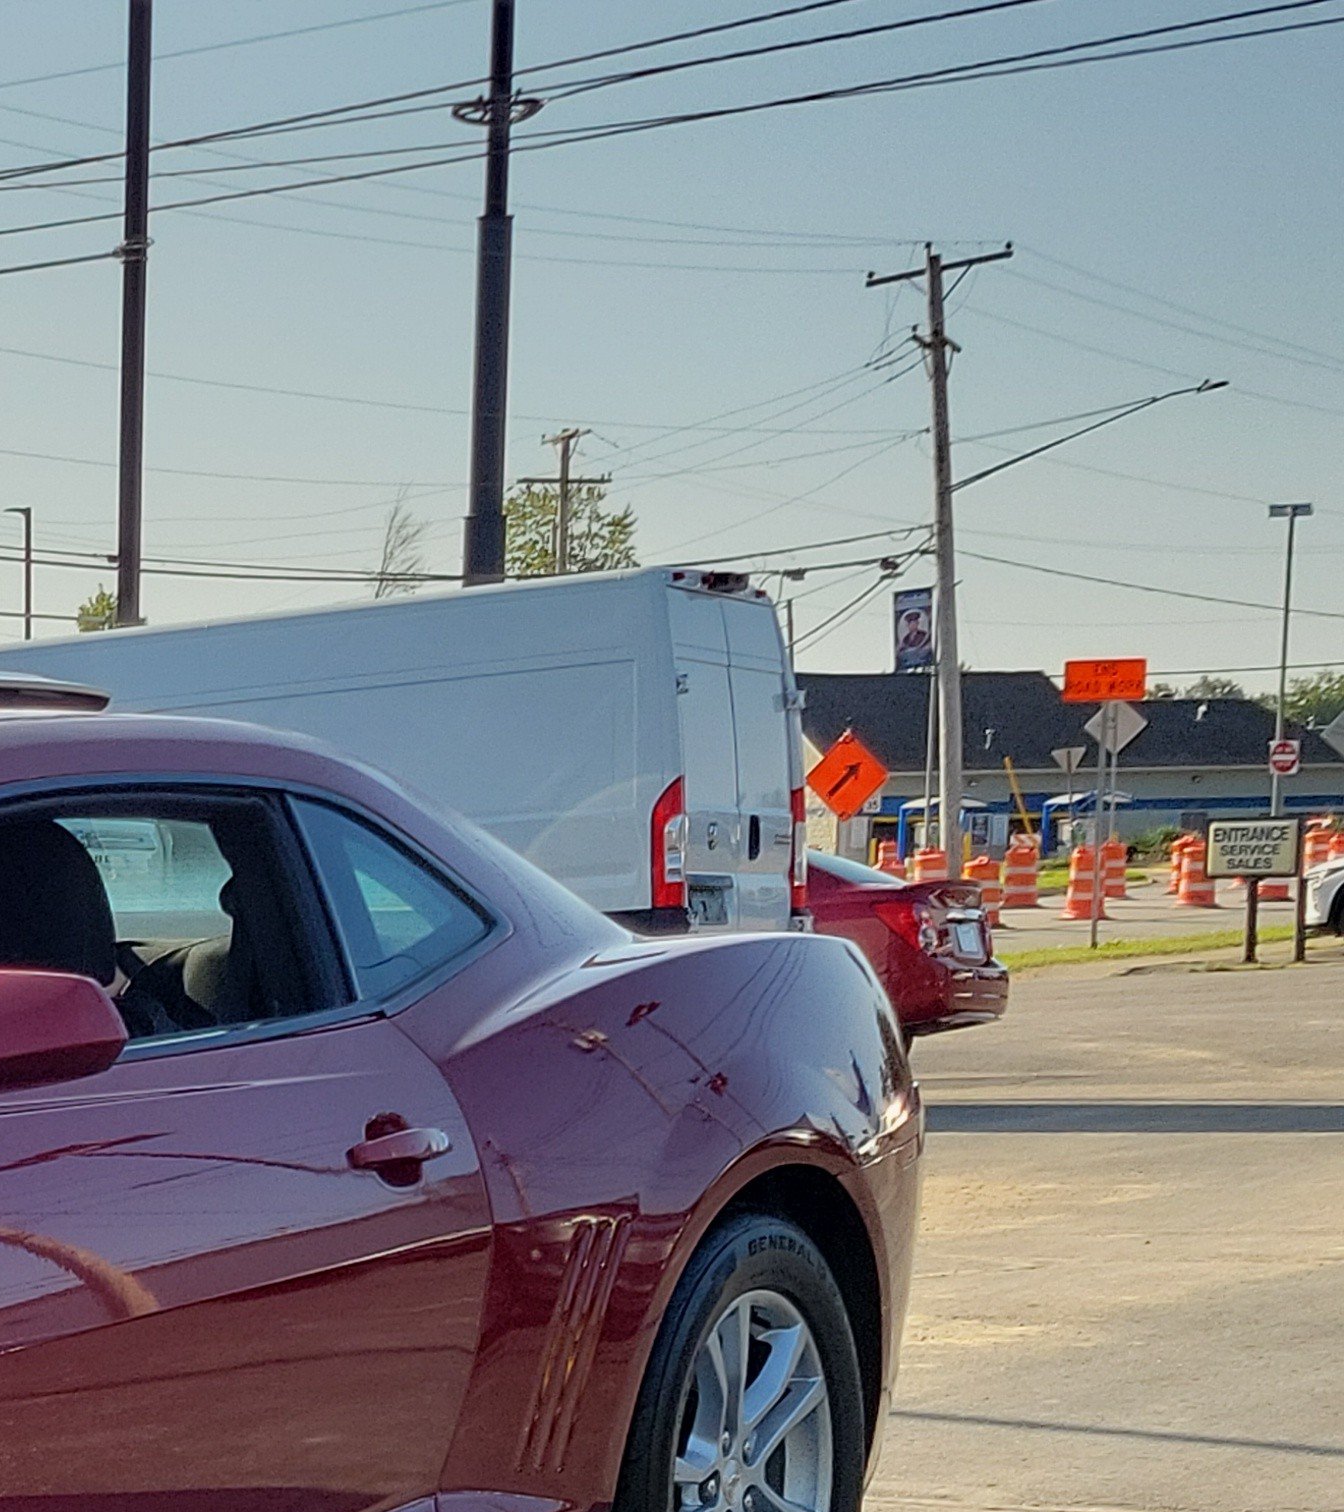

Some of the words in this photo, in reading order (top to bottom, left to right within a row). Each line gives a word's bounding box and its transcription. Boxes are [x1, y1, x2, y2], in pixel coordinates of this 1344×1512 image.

[1213, 826, 1291, 842] ENTRANCE
[1220, 843, 1280, 857] SERVICE
[1226, 857, 1273, 870] SALES
[748, 1234, 815, 1267] GENERAL
